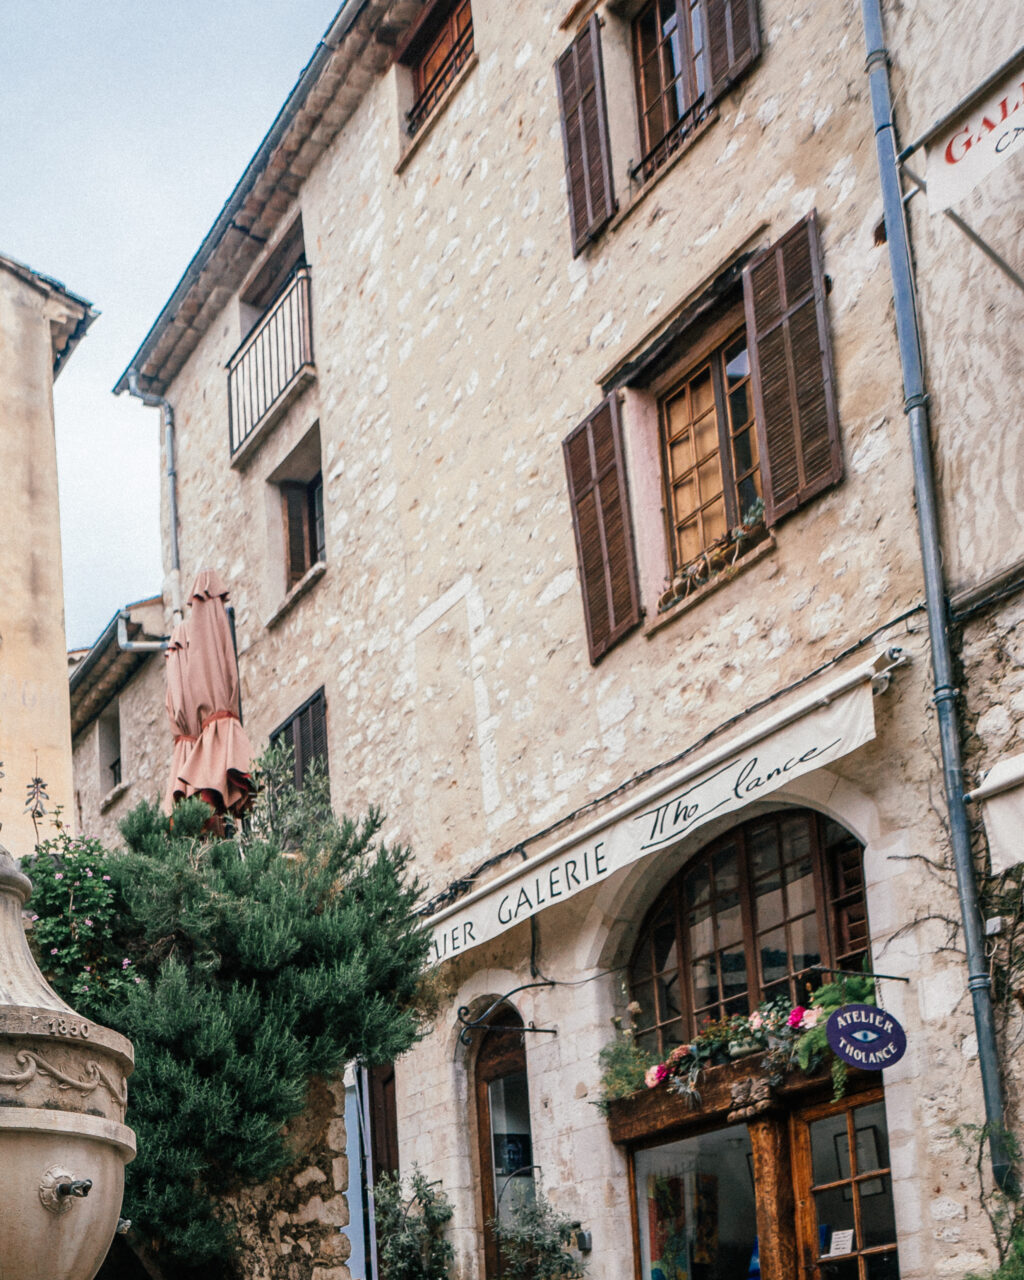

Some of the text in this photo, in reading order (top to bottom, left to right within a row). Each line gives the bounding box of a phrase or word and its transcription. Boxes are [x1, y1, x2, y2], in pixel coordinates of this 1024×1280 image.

[945, 82, 1024, 164] GAL
[497, 841, 609, 926] GALERIE
[836, 1010, 894, 1034] ATELIER
[839, 1037, 898, 1064] THOLANCE
